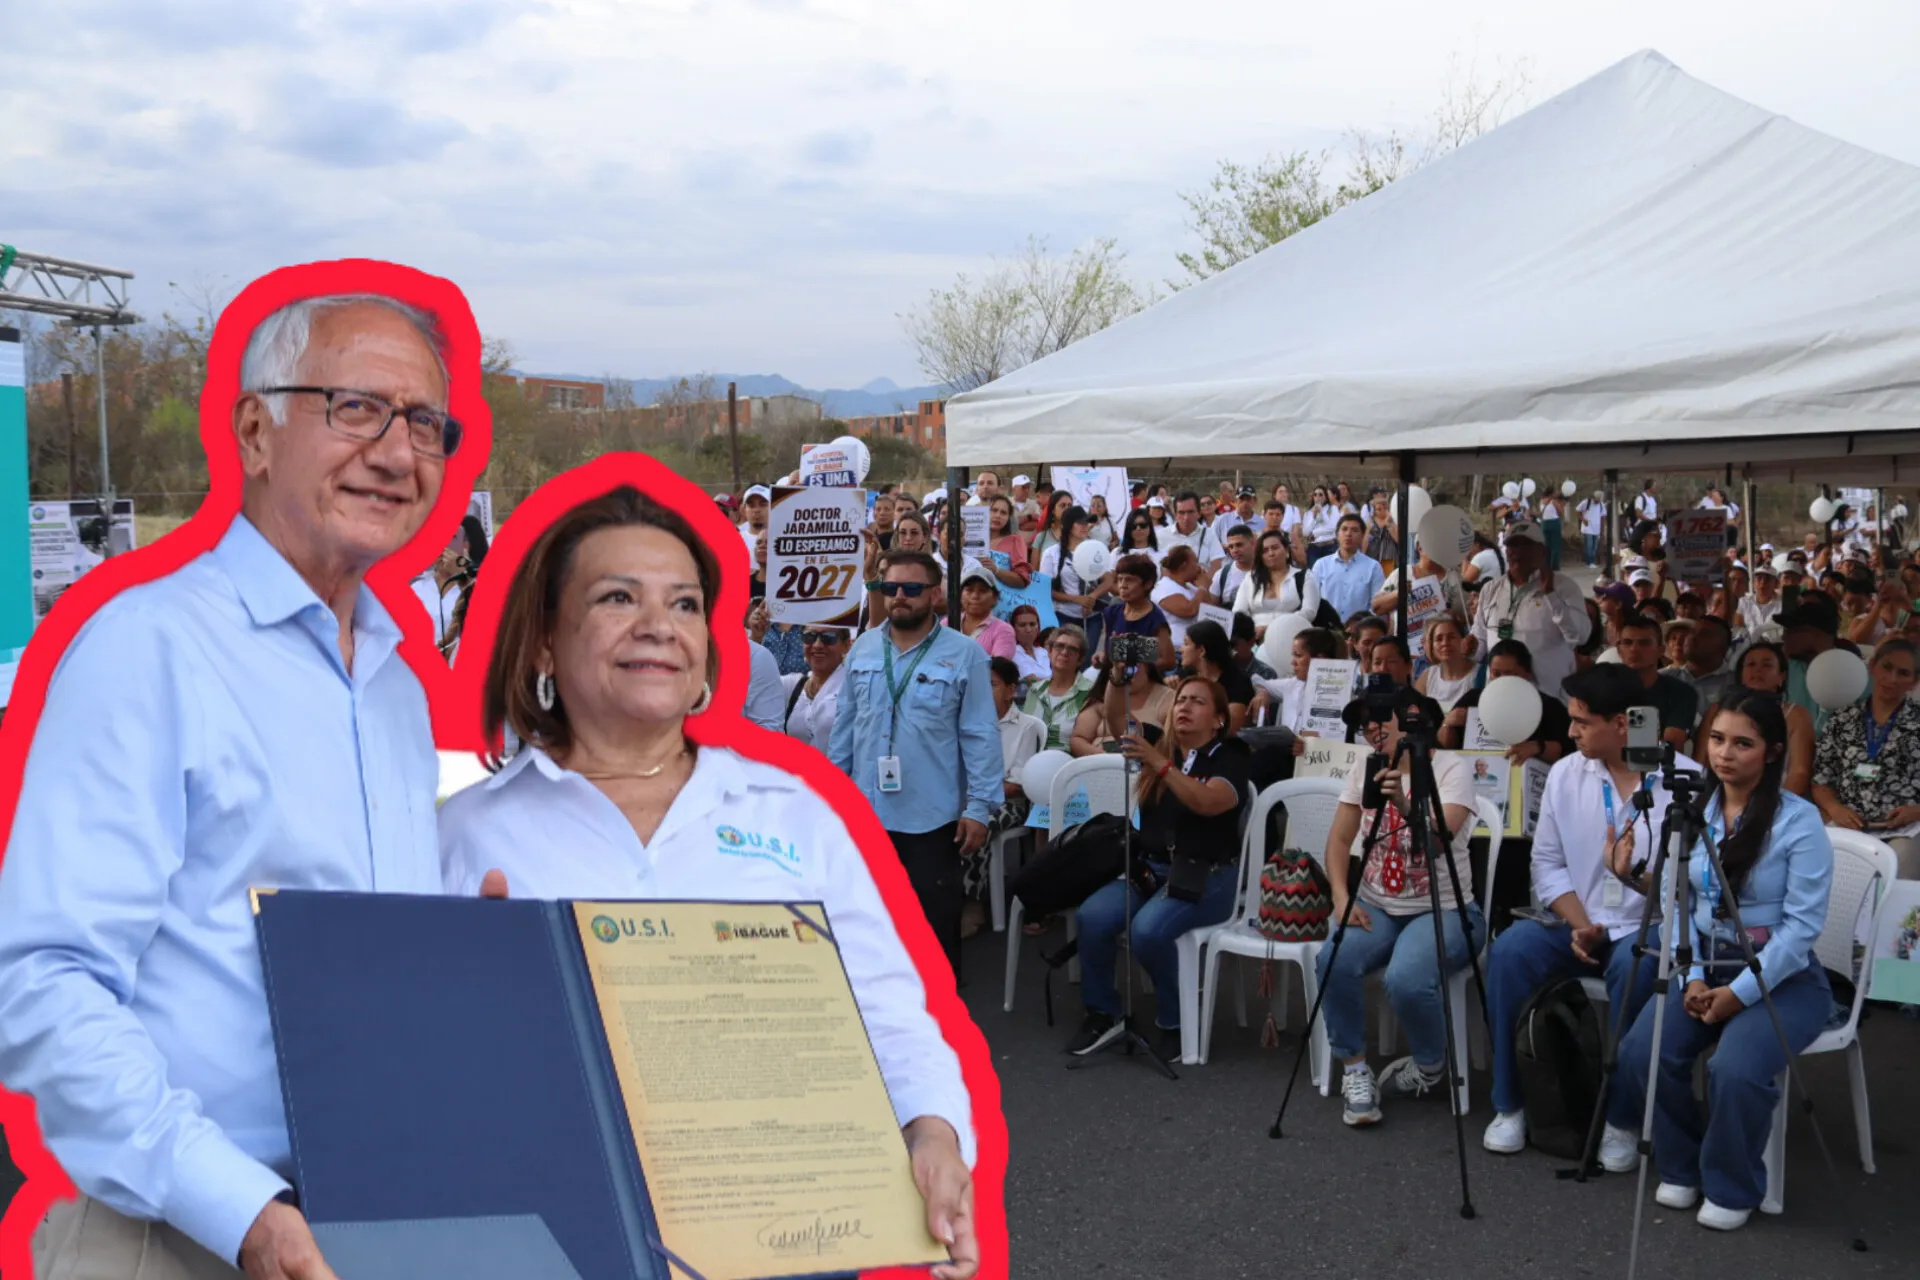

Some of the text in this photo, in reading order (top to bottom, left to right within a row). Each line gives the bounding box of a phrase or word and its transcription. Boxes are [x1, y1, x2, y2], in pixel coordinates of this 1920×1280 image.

[809, 471, 851, 488] ES UNA
[793, 508, 841, 521] DOCTOR
[782, 520, 852, 535] JARAMILLO,
[1675, 516, 1724, 535] 1.762
[779, 537, 856, 553] LO ESPERAMOS
[804, 556, 829, 565] EN EL
[775, 564, 857, 599] 2027
[1304, 750, 1331, 766] SAN
[746, 831, 801, 863] U.S.I.
[620, 917, 676, 938] U.S.I.
